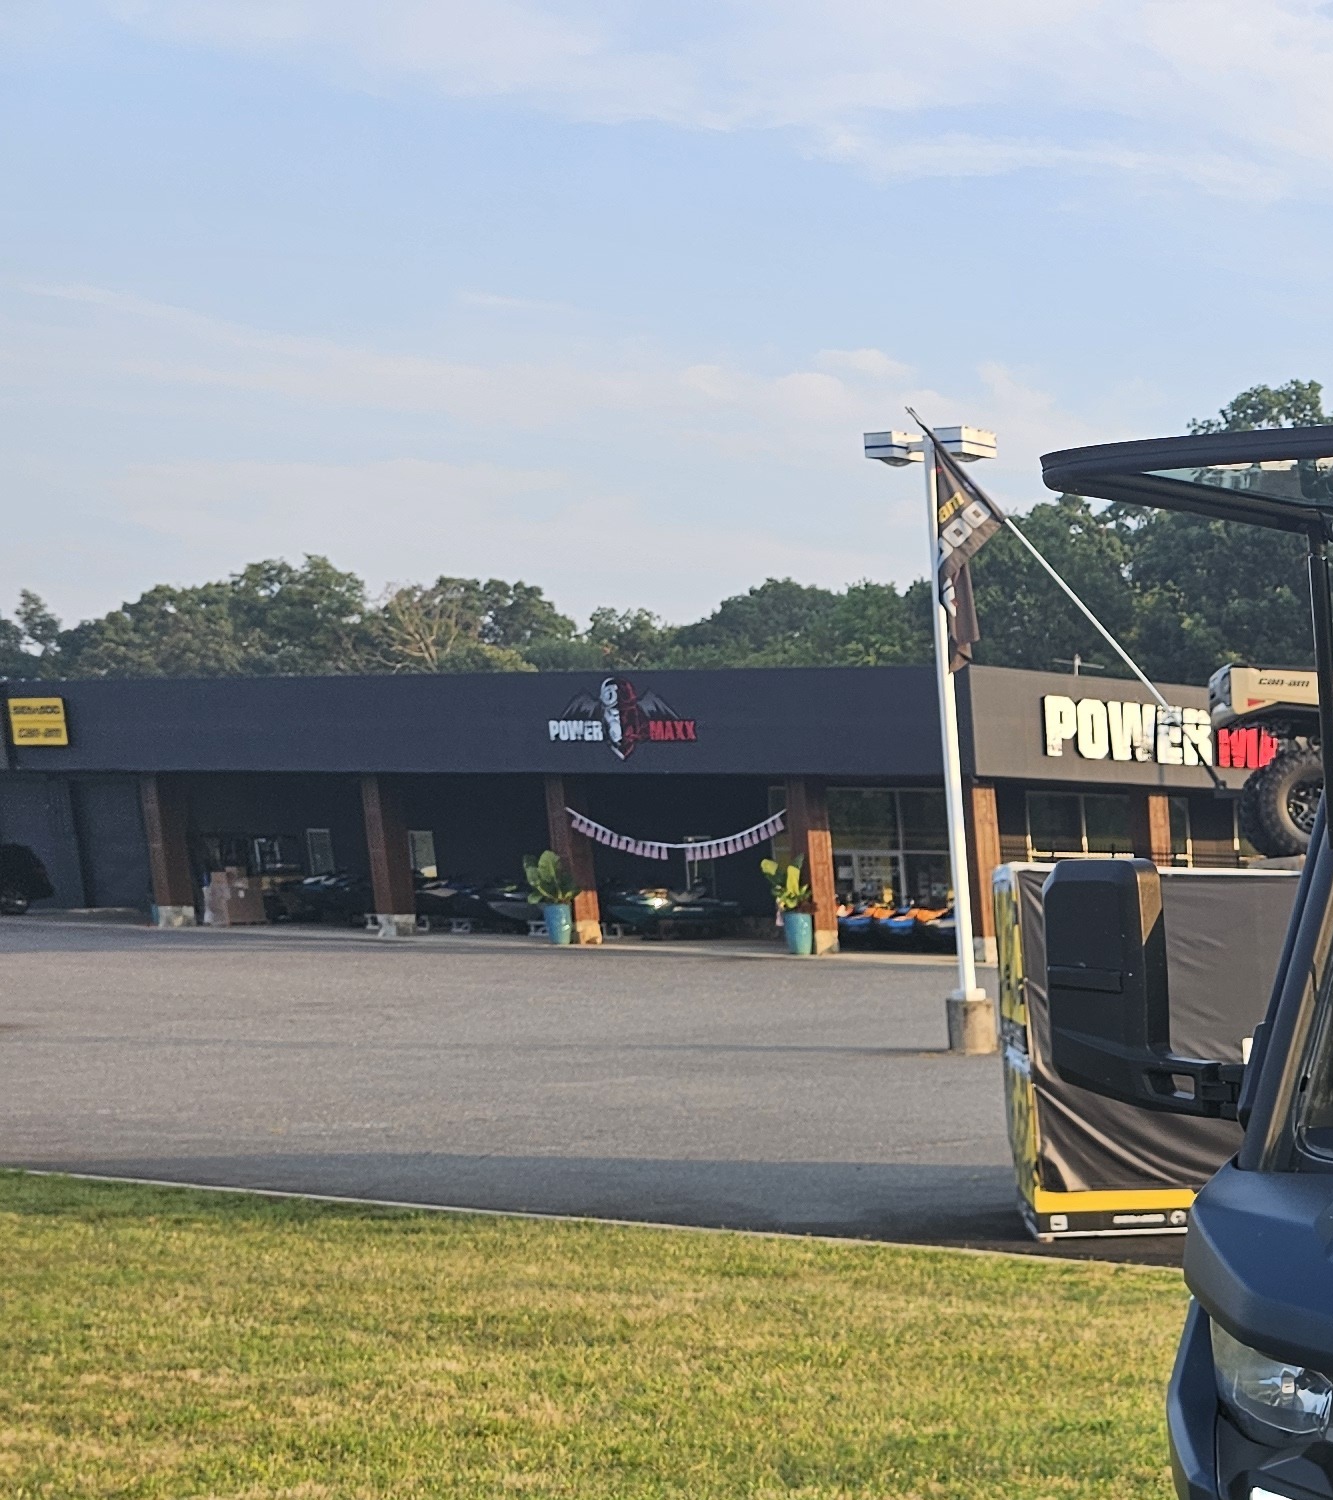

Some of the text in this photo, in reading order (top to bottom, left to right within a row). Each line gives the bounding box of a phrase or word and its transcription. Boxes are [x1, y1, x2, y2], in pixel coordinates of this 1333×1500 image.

[1258, 678, 1310, 688] can-am
[548, 719, 697, 741] POWER MAXX
[1043, 694, 1212, 767] POWER
